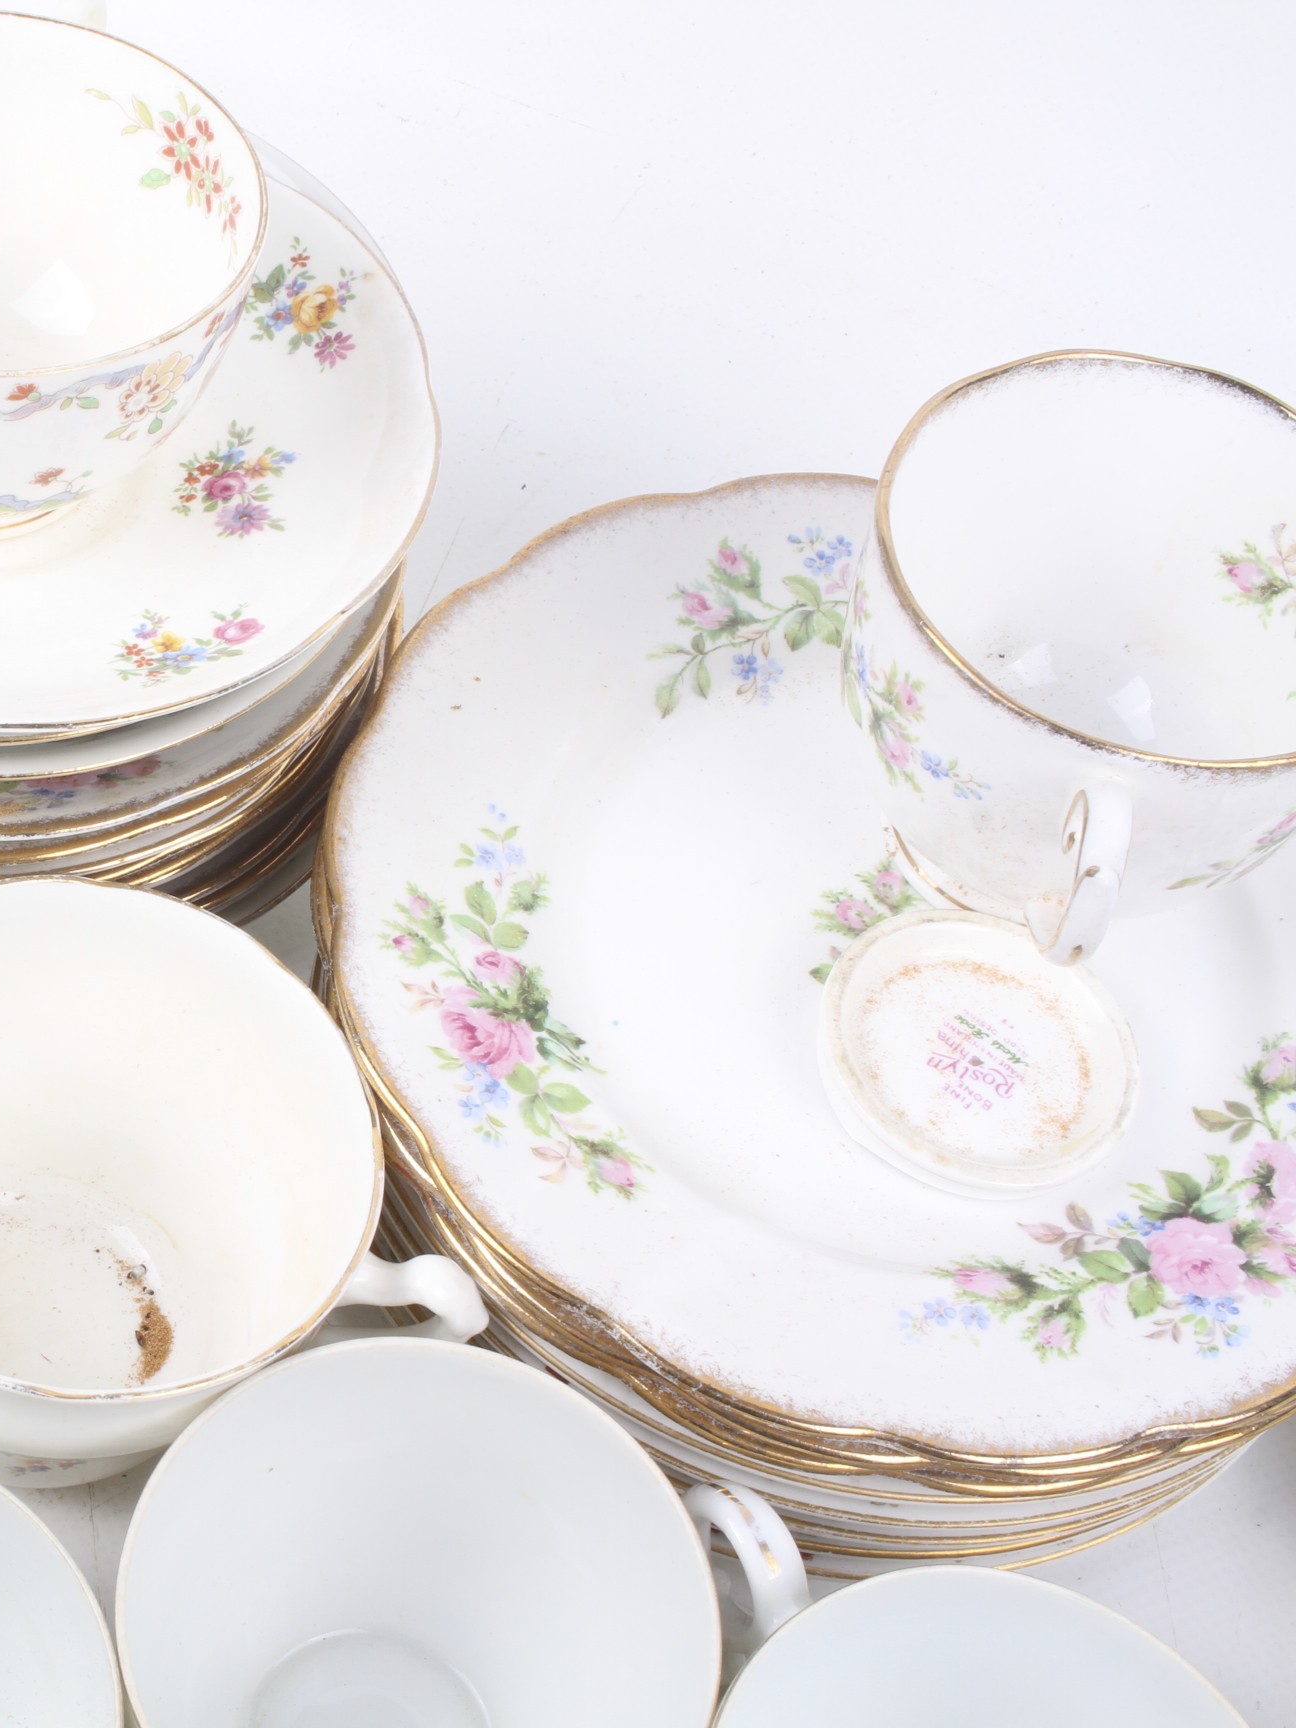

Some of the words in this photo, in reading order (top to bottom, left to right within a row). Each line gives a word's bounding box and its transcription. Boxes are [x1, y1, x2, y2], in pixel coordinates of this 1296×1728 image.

[926, 1051, 1016, 1099] Roslyn
[943, 1083, 973, 1110] FINE
[957, 1080, 993, 1111] BONE
